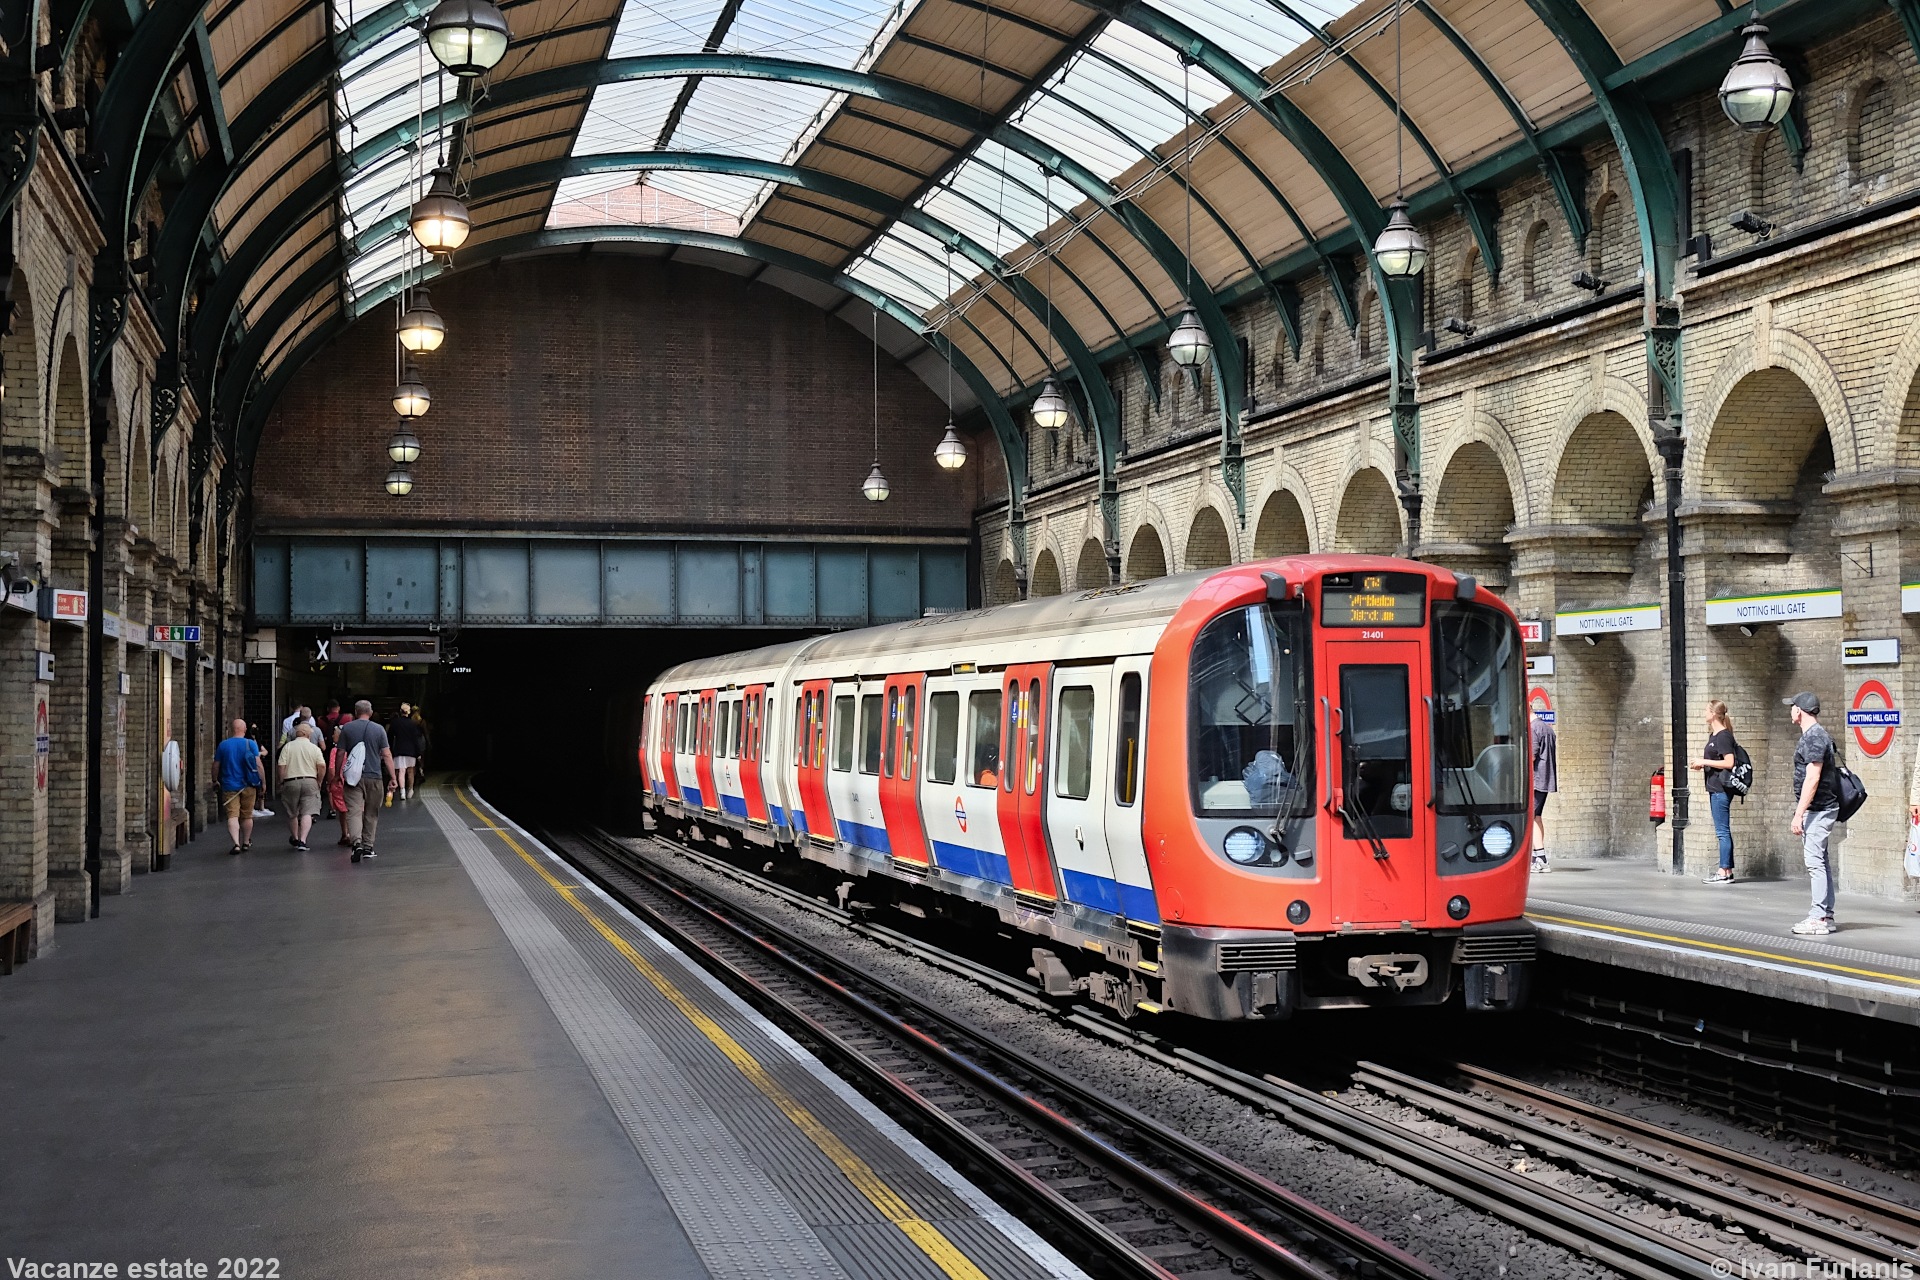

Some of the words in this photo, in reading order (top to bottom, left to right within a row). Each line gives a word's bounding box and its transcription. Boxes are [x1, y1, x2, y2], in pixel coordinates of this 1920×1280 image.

[1737, 605, 1769, 617] NOTTING
[1770, 604, 1785, 615] HILL
[1787, 602, 1806, 614] GATE
[1579, 618, 1605, 629] NOTTING
[1605, 617, 1617, 627] HILL
[1618, 616, 1633, 627] GATE
[1362, 631, 1384, 639] 21401
[1849, 714, 1873, 723] NOTTING
[1873, 714, 1884, 722] HILL
[1884, 713, 1898, 722] GATE
